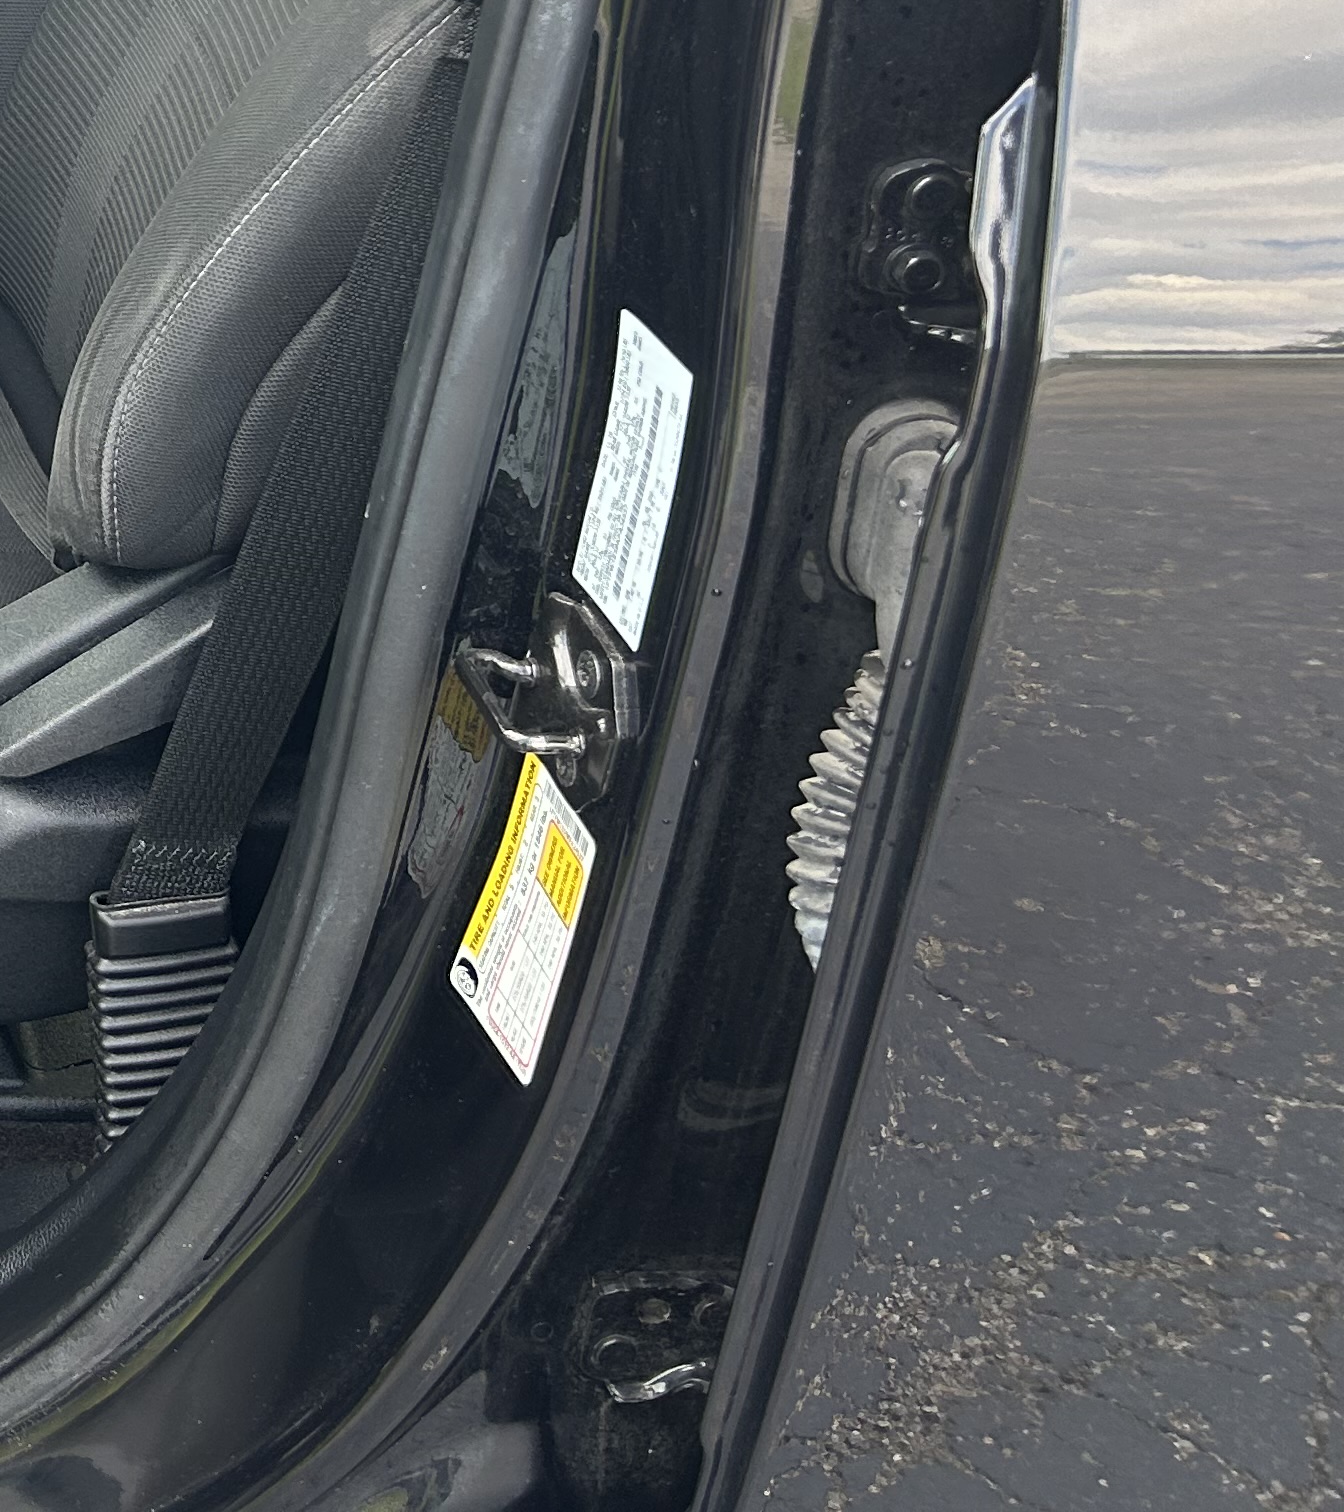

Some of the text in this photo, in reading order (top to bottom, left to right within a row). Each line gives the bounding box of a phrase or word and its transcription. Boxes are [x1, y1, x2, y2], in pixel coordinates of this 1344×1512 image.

[469, 760, 537, 951] TIRE AND LOADING INFORMATION
